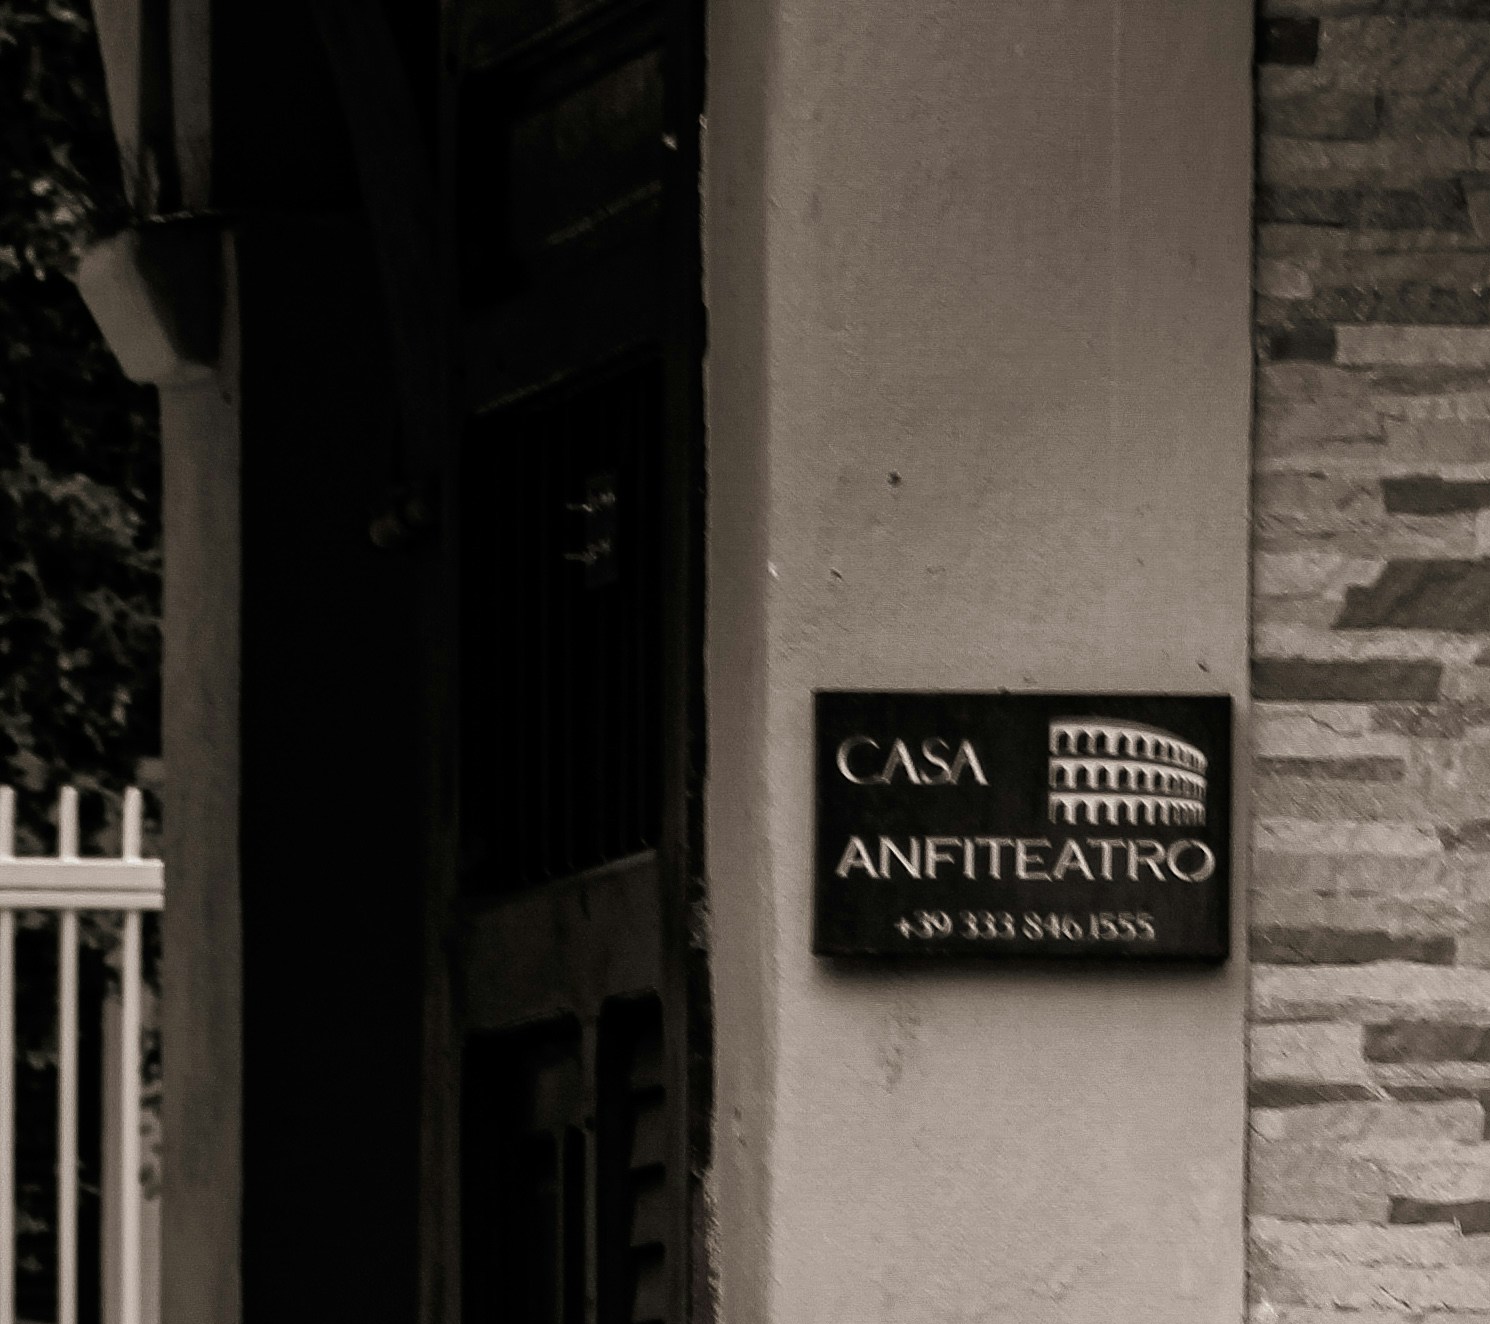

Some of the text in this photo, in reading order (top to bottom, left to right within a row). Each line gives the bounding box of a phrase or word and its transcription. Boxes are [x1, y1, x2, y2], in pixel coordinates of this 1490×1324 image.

[837, 736, 989, 785] CASA
[835, 835, 1216, 883] ANFITEATRO
[895, 910, 1155, 941] +39 333 846 1555
